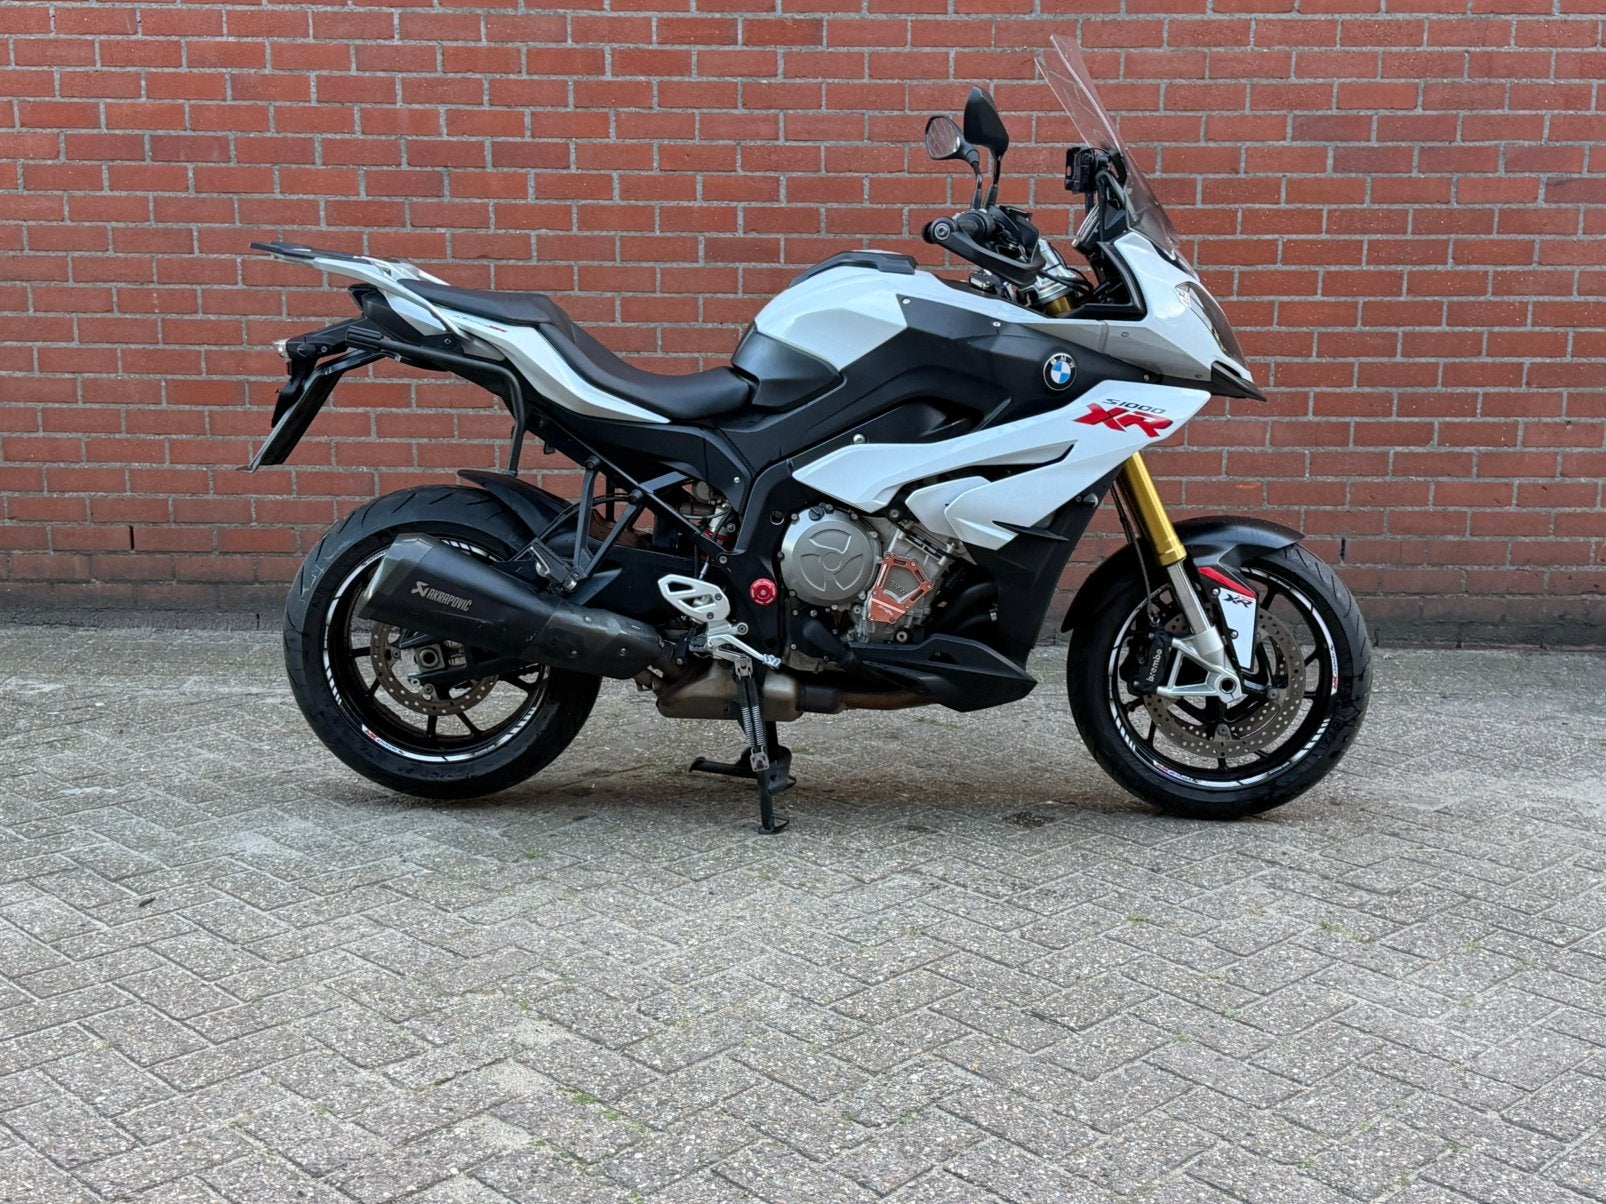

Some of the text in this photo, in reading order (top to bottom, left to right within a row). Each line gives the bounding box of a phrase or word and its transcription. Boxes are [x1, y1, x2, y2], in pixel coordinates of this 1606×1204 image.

[1050, 355, 1076, 368] BMW
[1072, 403, 1174, 438] XR
[1146, 649, 1163, 682] brembo
